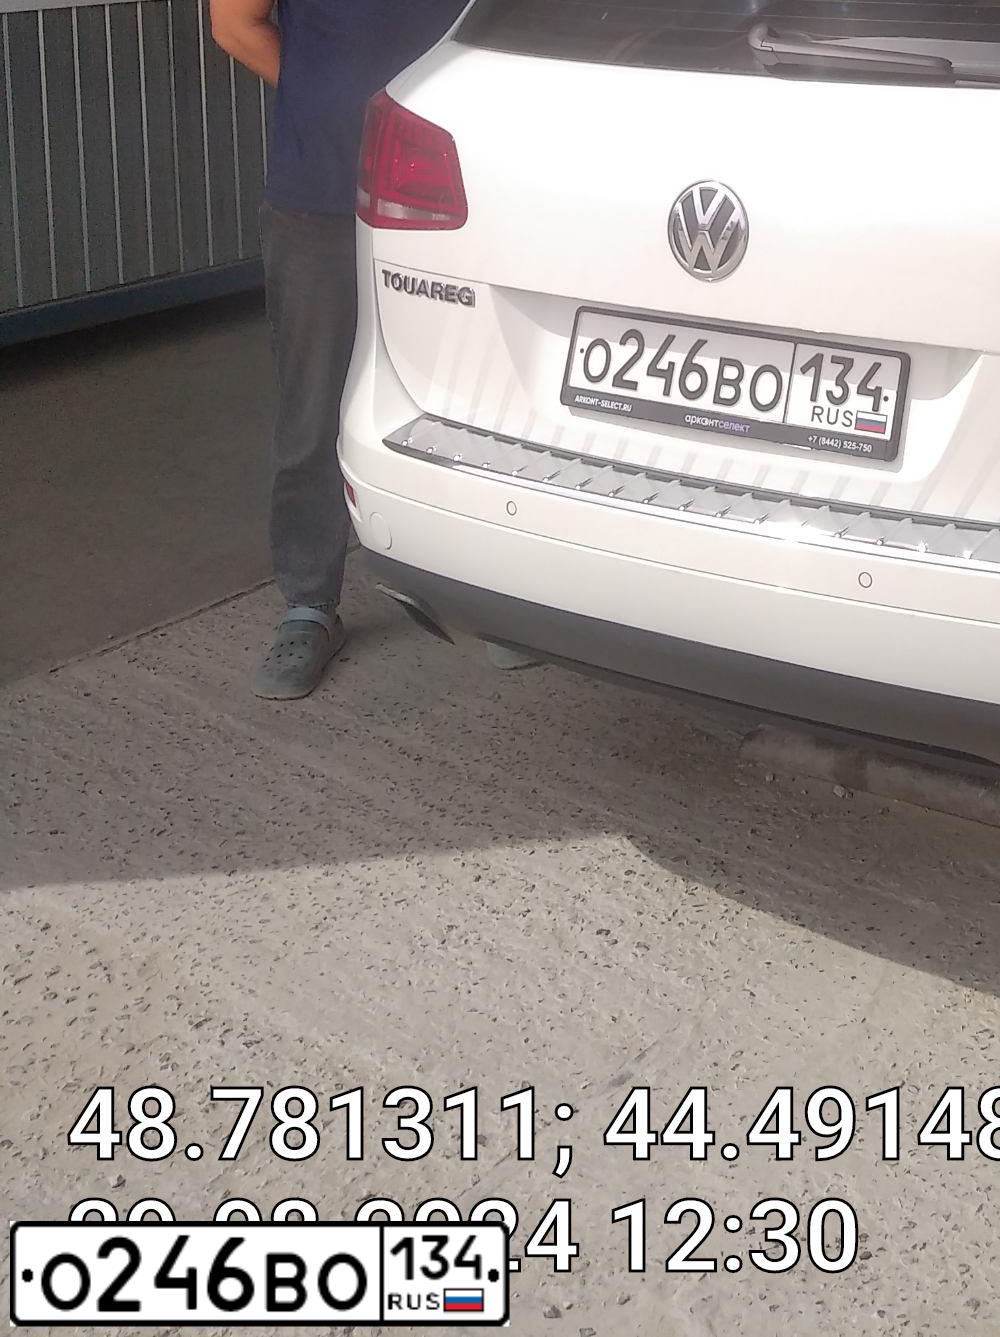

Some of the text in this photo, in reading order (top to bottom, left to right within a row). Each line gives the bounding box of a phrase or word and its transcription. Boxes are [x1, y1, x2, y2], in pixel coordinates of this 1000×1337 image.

[381, 268, 476, 308] TOUAREG
[800, 352, 882, 413] 134
[574, 394, 633, 413] ARKONT-SELECT.RU
[811, 405, 854, 428] RUS
[808, 434, 818, 444] +7
[818, 436, 842, 448] (8442)
